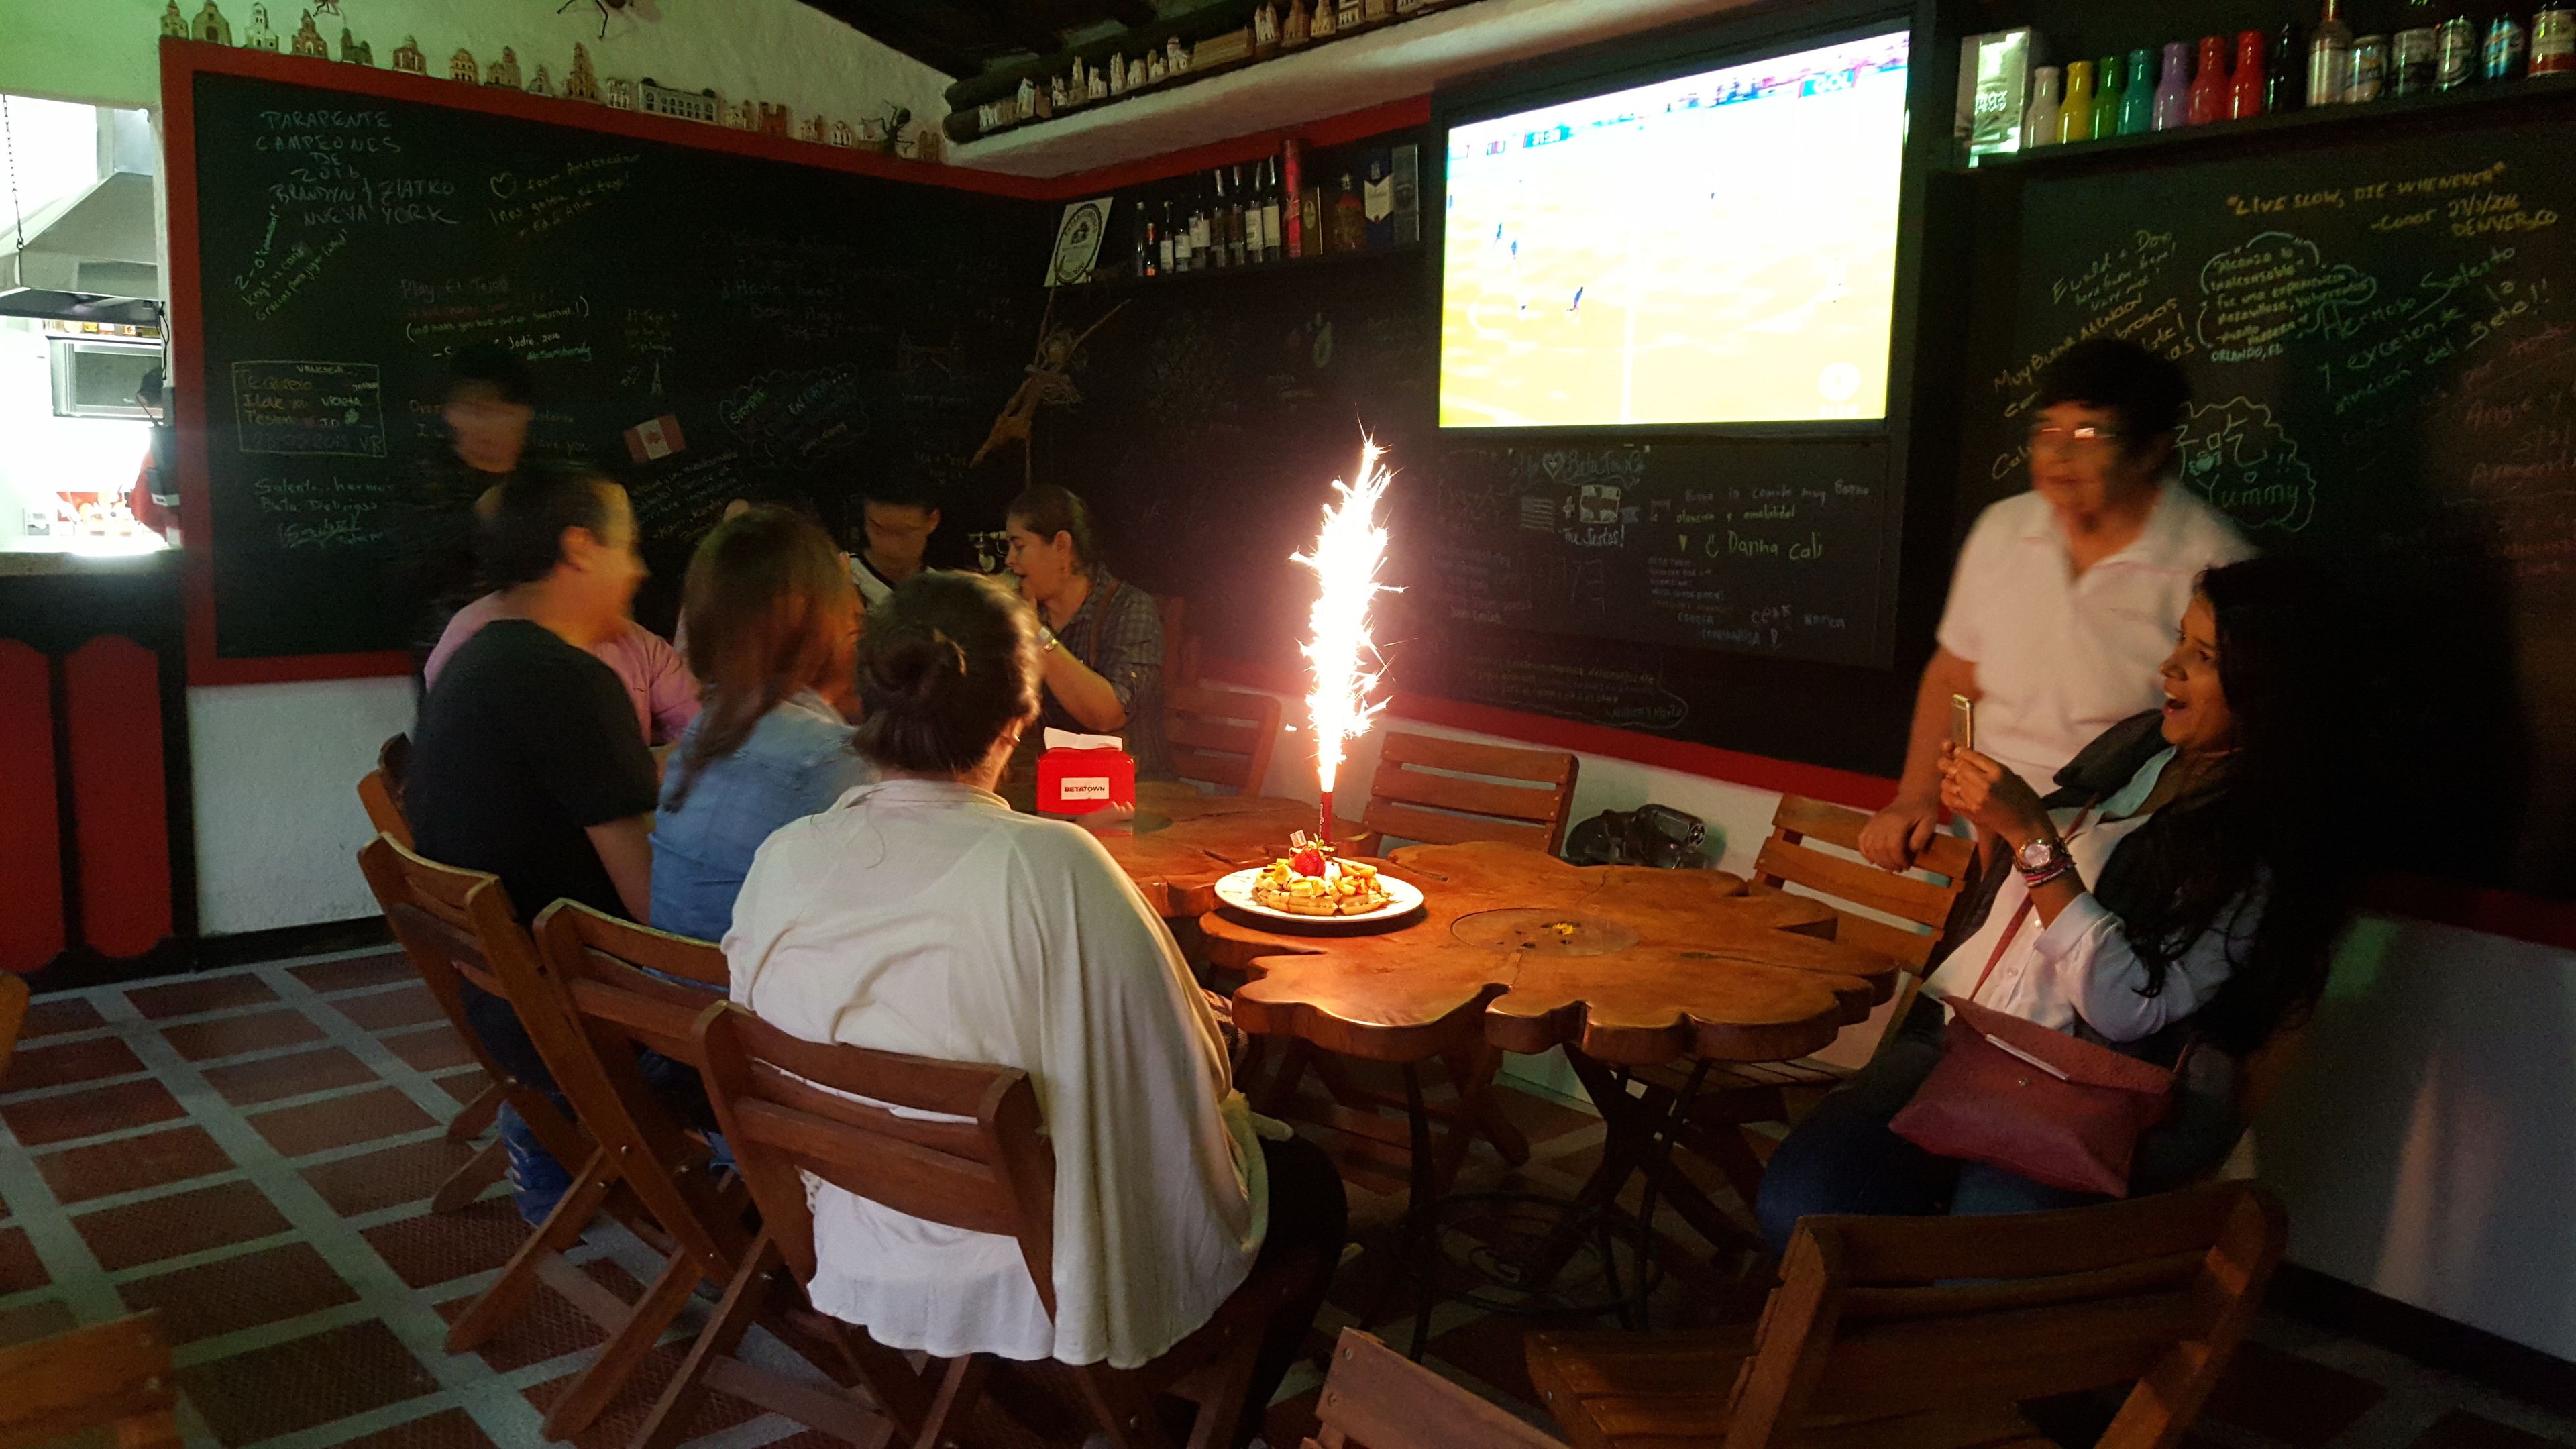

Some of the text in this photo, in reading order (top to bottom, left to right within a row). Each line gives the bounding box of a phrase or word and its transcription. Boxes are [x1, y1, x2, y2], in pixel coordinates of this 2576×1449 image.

[1812, 70, 1854, 94] GOL
[256, 136, 401, 154] CAMPEONES
[309, 151, 341, 166] DE
[2353, 182, 2389, 201] DIE
[380, 204, 460, 226] YORK
[2196, 473, 2299, 525] Yummy
